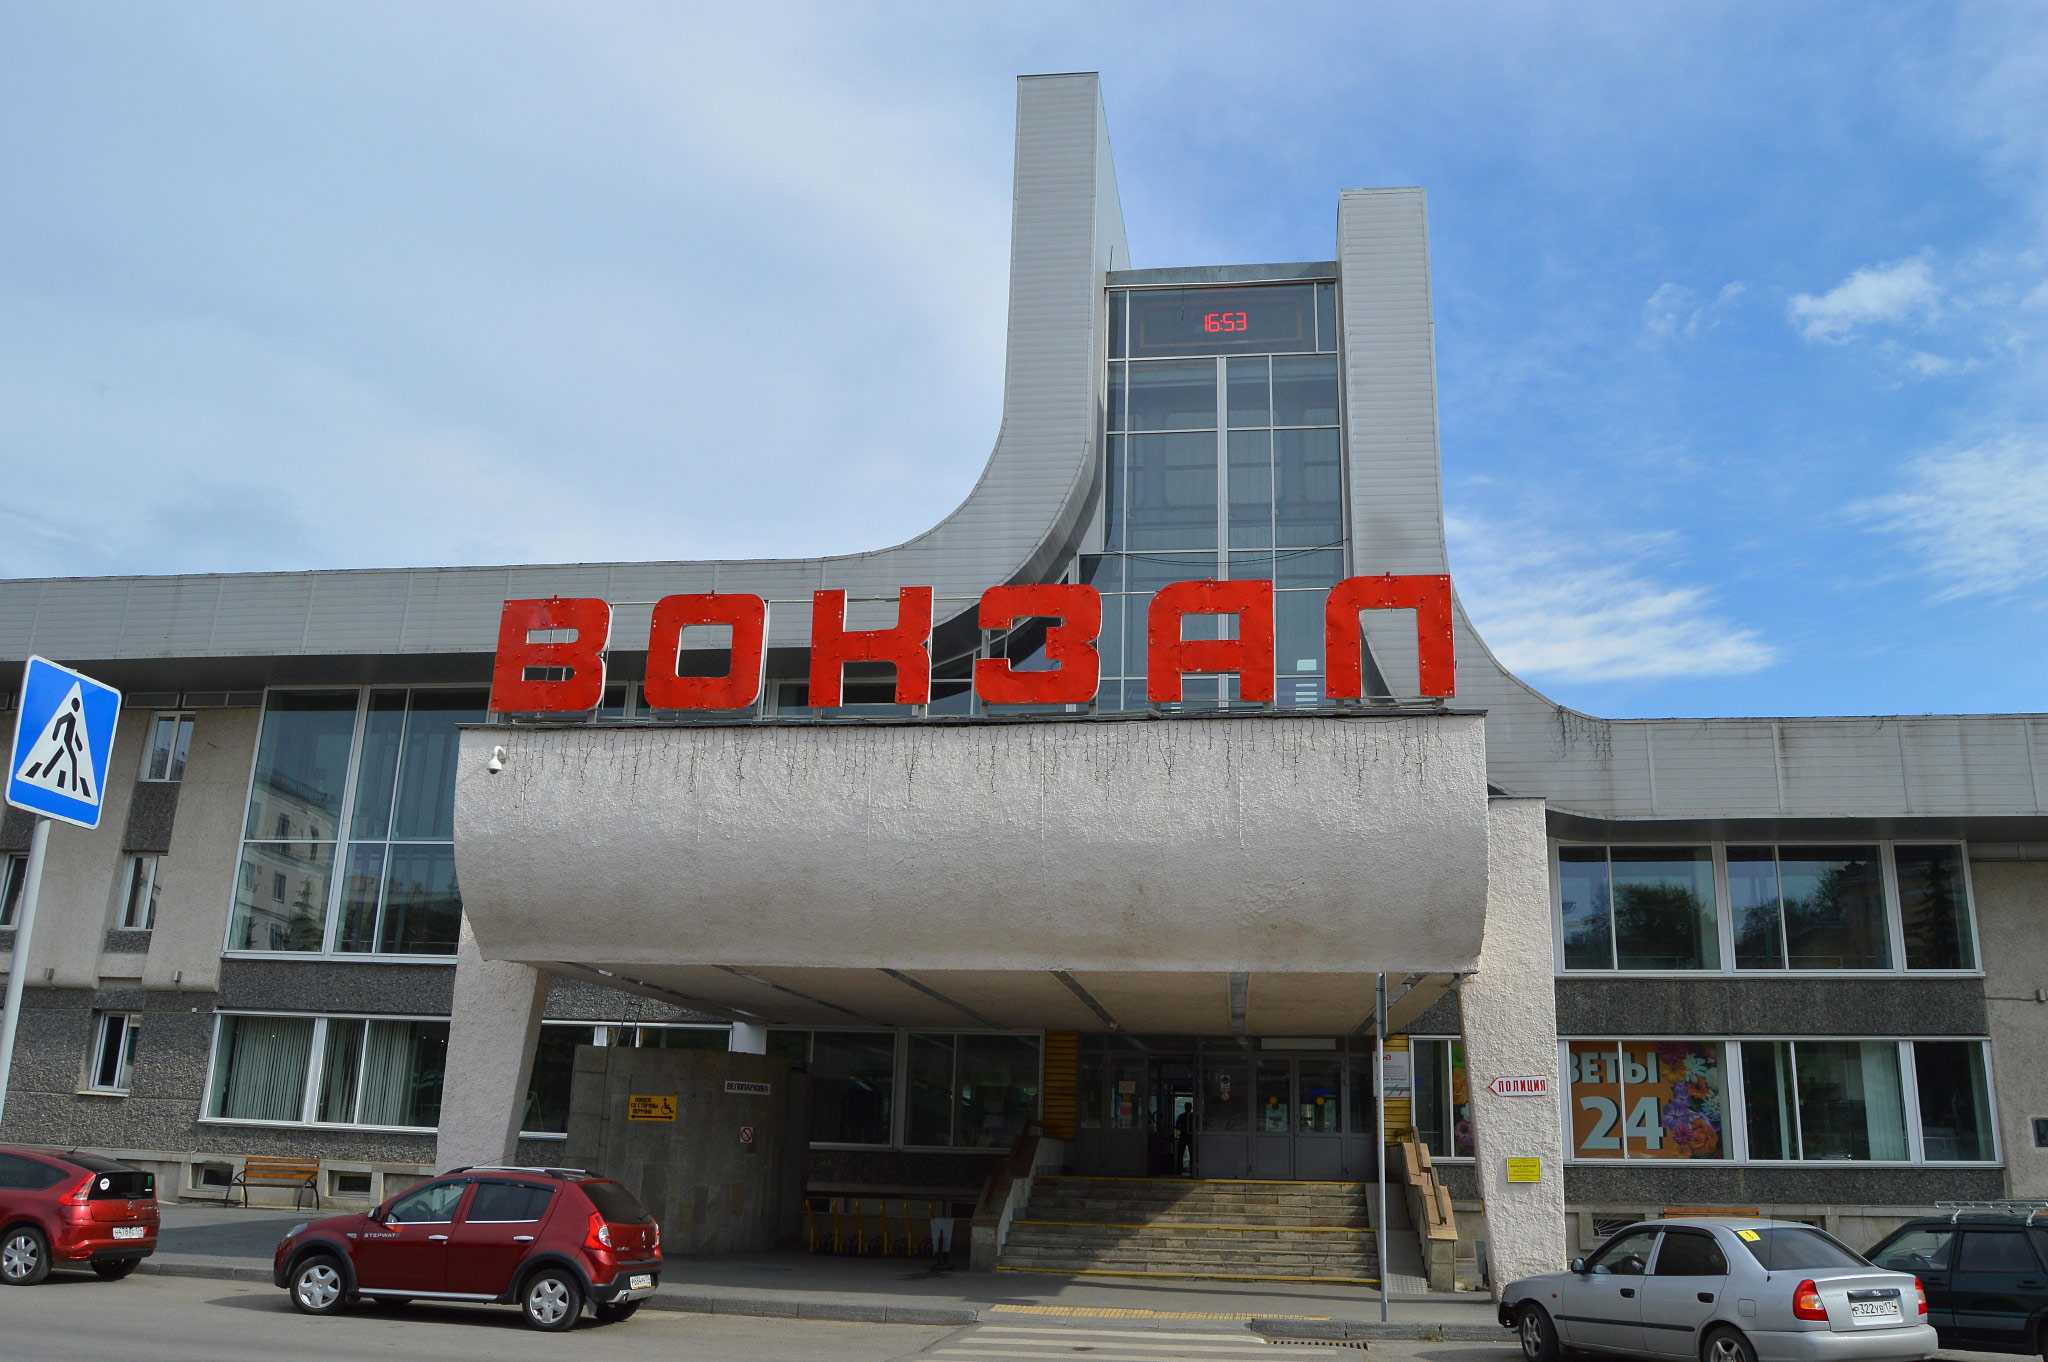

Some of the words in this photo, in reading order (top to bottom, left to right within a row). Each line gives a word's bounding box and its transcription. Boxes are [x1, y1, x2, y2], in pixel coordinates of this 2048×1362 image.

[1205, 312, 1247, 332] 16:53
[491, 573, 1455, 712] ВОКЗАЛ
[726, 1082, 769, 1093] ВЕЛОПАРКОВКА
[1498, 1080, 1546, 1093] ПОЛИЦИЯ
[1580, 1096, 1664, 1150] 24
